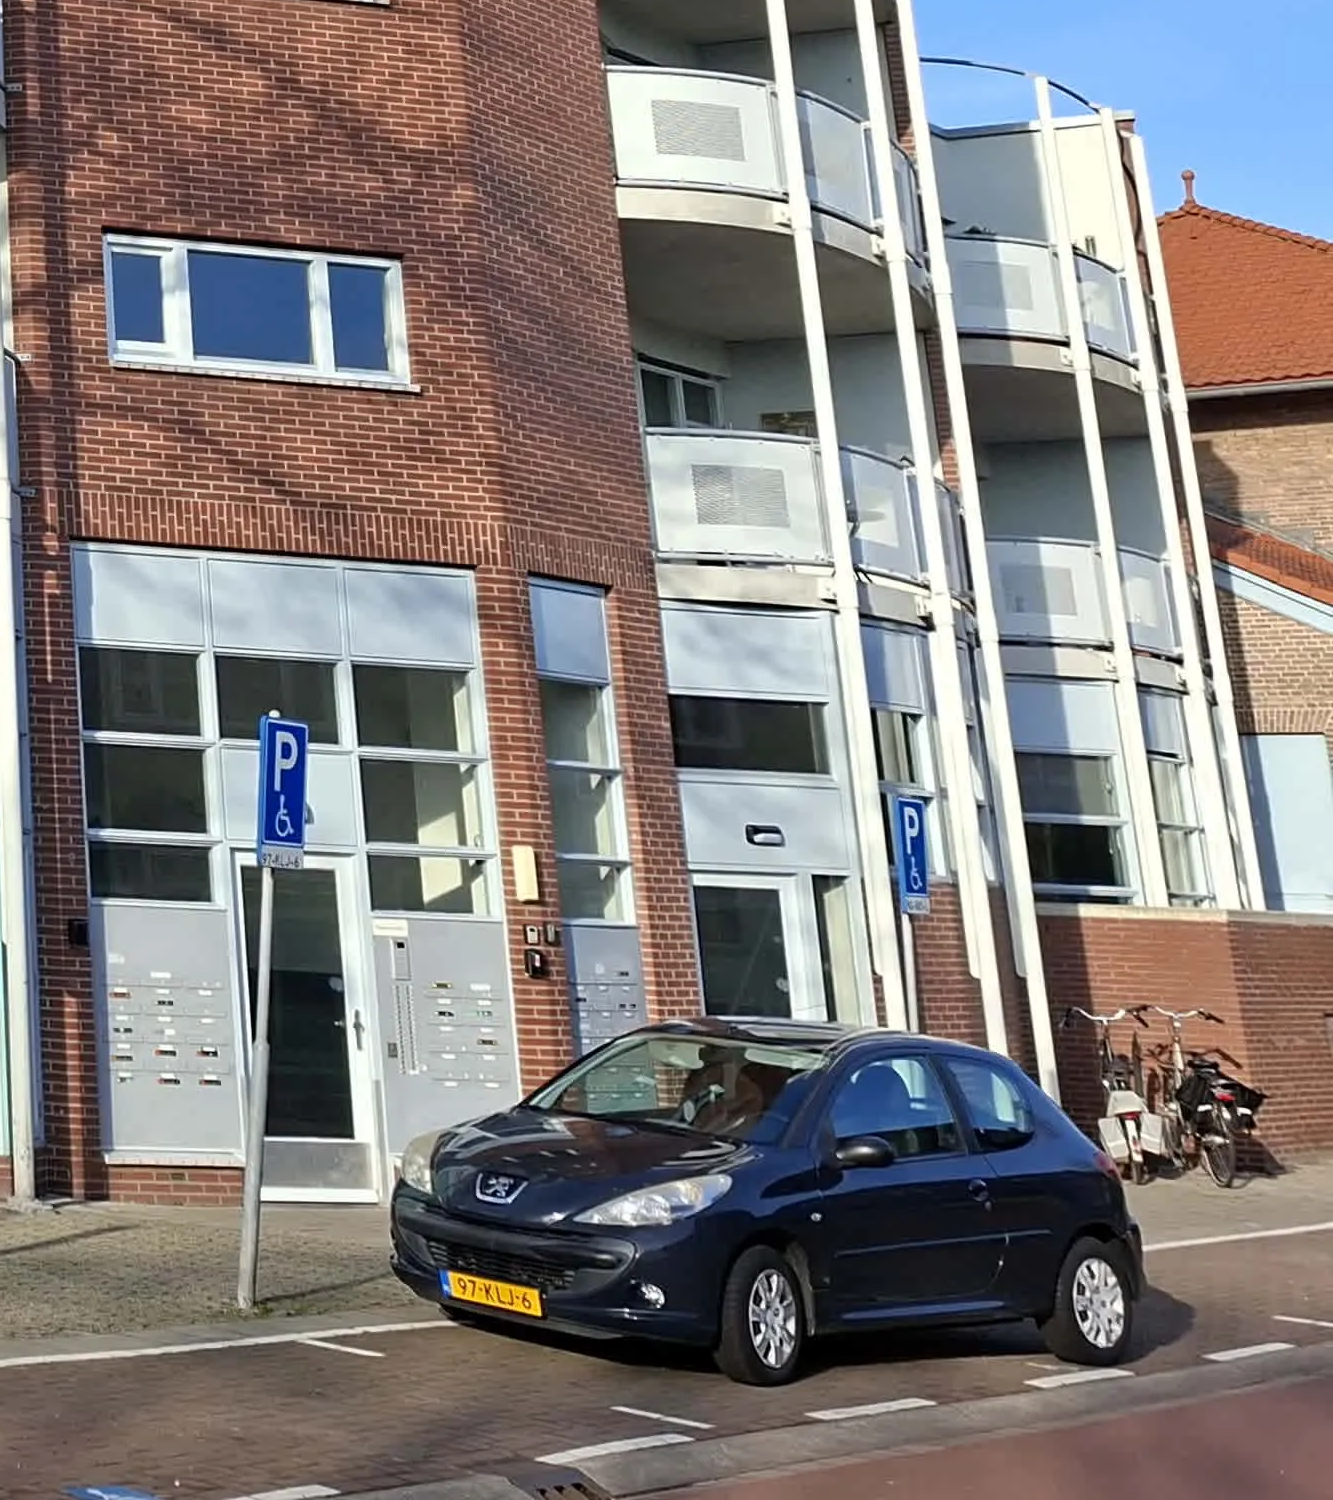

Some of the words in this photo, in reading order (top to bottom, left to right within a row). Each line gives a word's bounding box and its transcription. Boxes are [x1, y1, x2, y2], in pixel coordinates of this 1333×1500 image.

[273, 731, 299, 792] P
[903, 806, 920, 855] P
[457, 1277, 532, 1310] 97-KLJ-6
